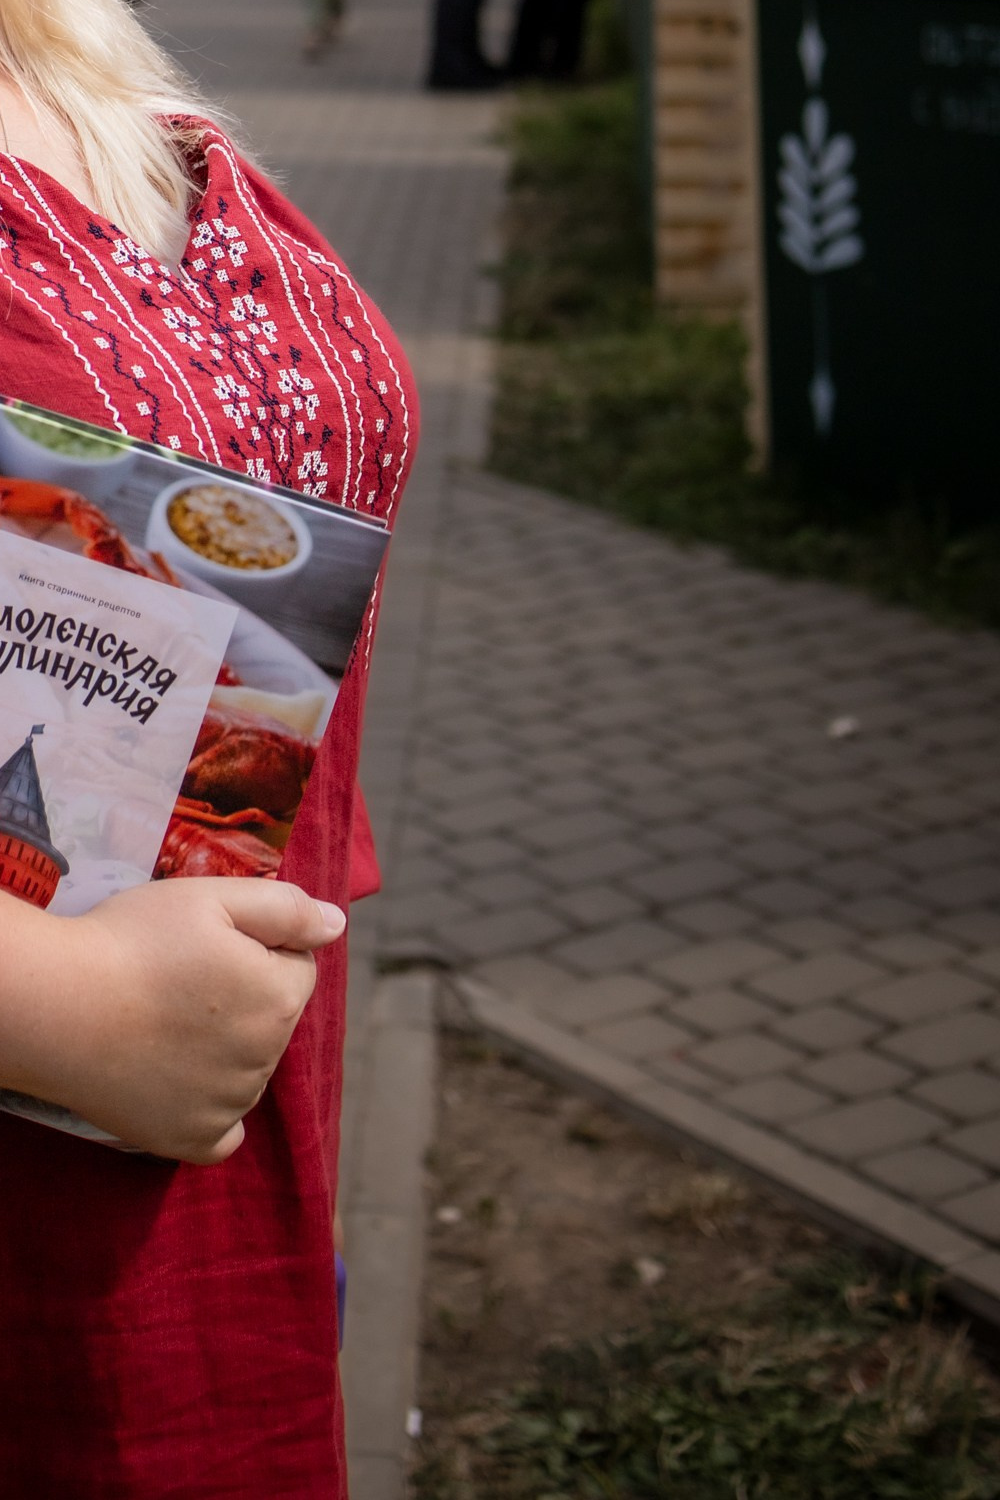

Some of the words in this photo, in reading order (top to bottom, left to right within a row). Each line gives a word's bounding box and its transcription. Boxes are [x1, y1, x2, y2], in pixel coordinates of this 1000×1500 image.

[18, 572, 46, 588] книга
[47, 581, 97, 604] старинных
[97, 598, 142, 619] рецептов
